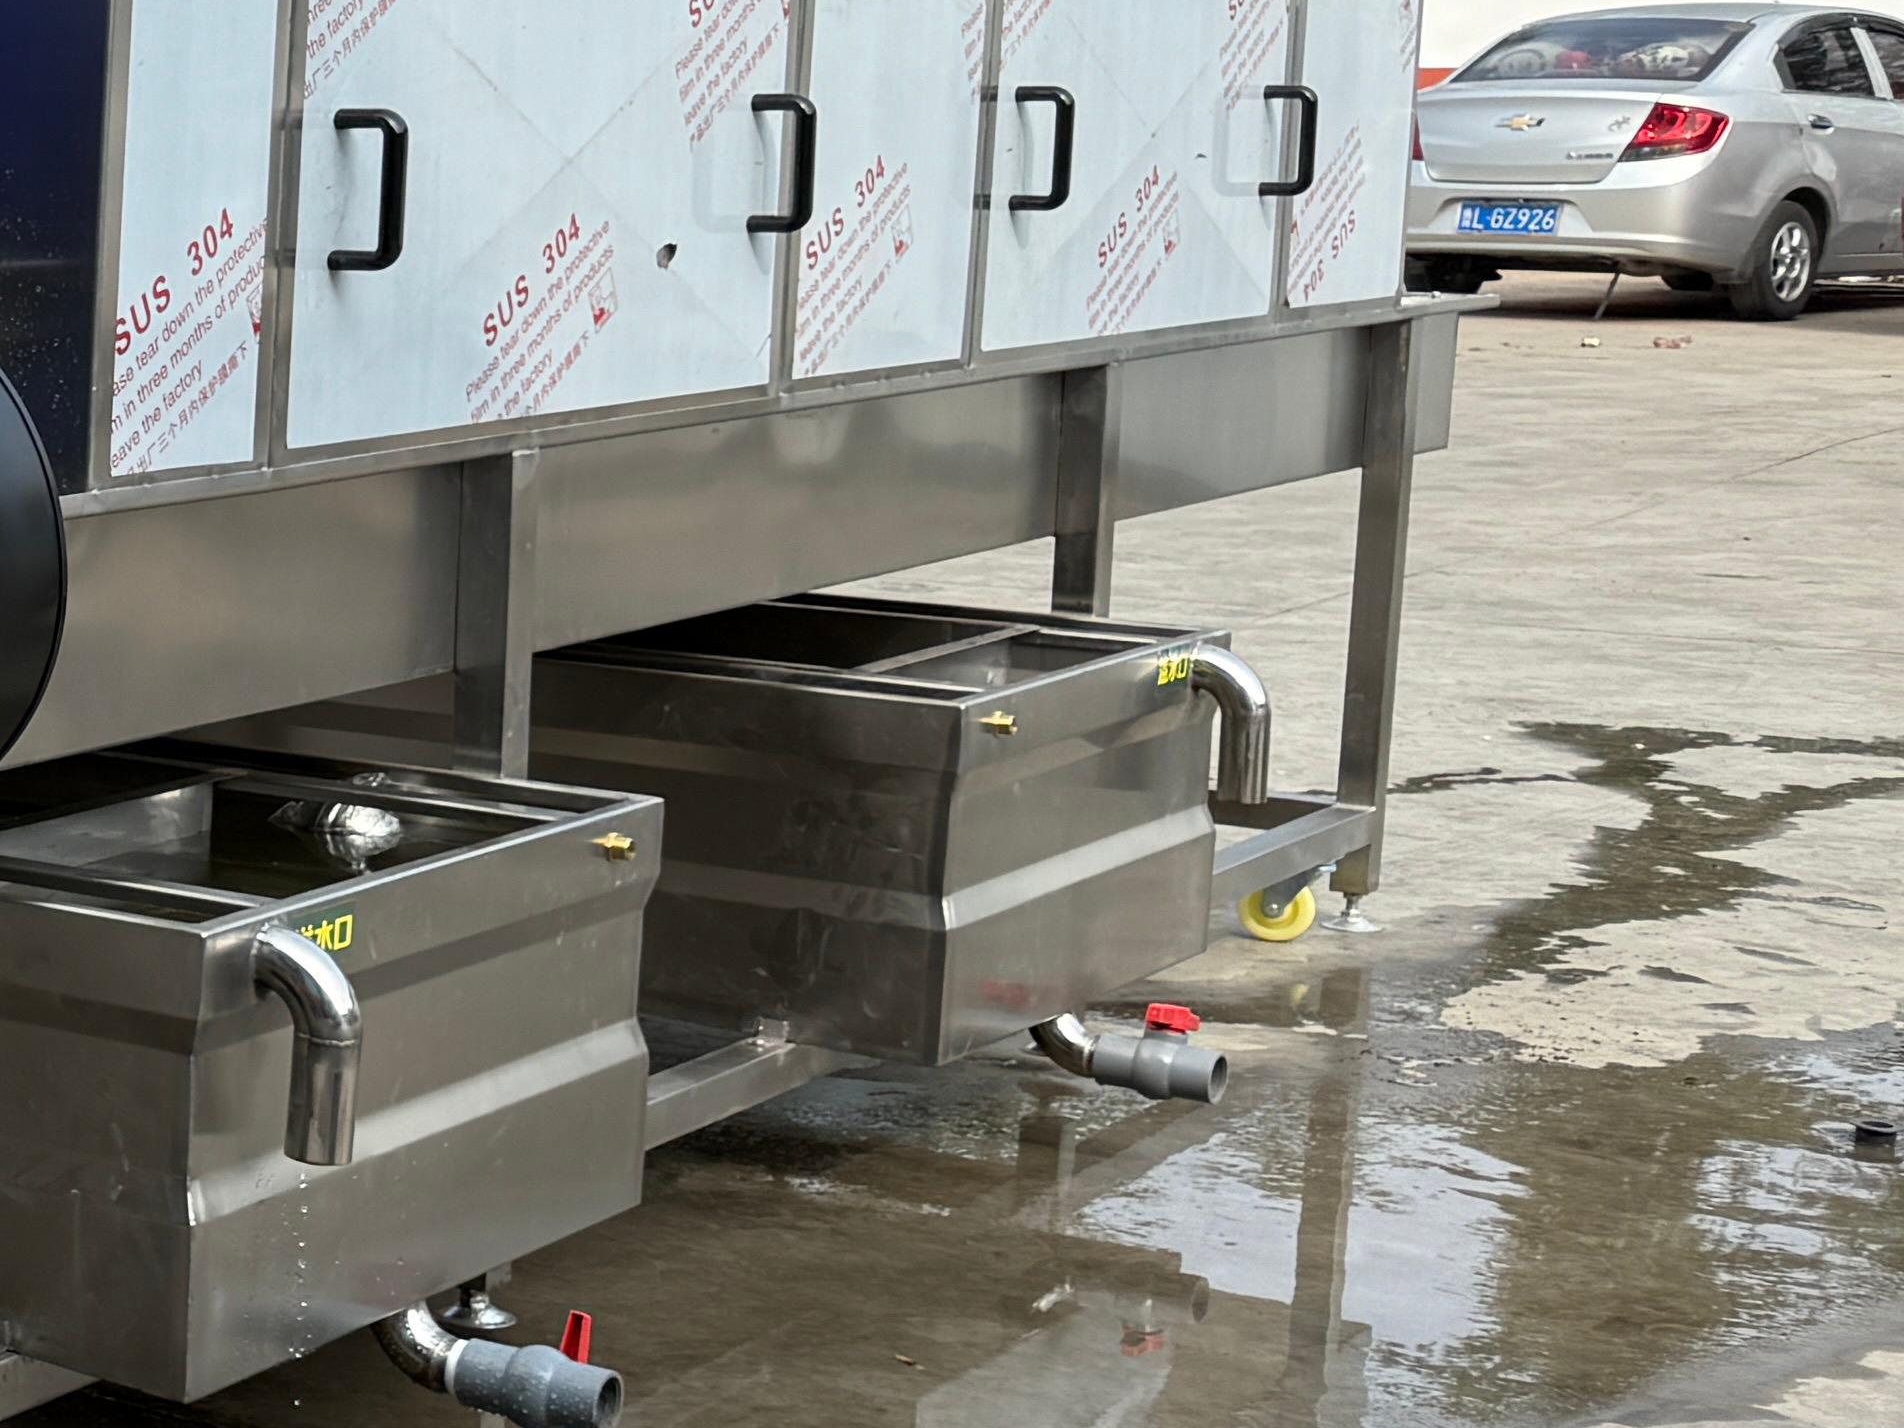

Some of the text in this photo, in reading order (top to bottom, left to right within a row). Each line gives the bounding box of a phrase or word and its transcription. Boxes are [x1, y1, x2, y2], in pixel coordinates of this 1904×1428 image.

[807, 155, 884, 270] SUS 304
[116, 208, 233, 355] SUS 304
[484, 214, 579, 346] SUS 304
[300, 914, 353, 951] 水口
